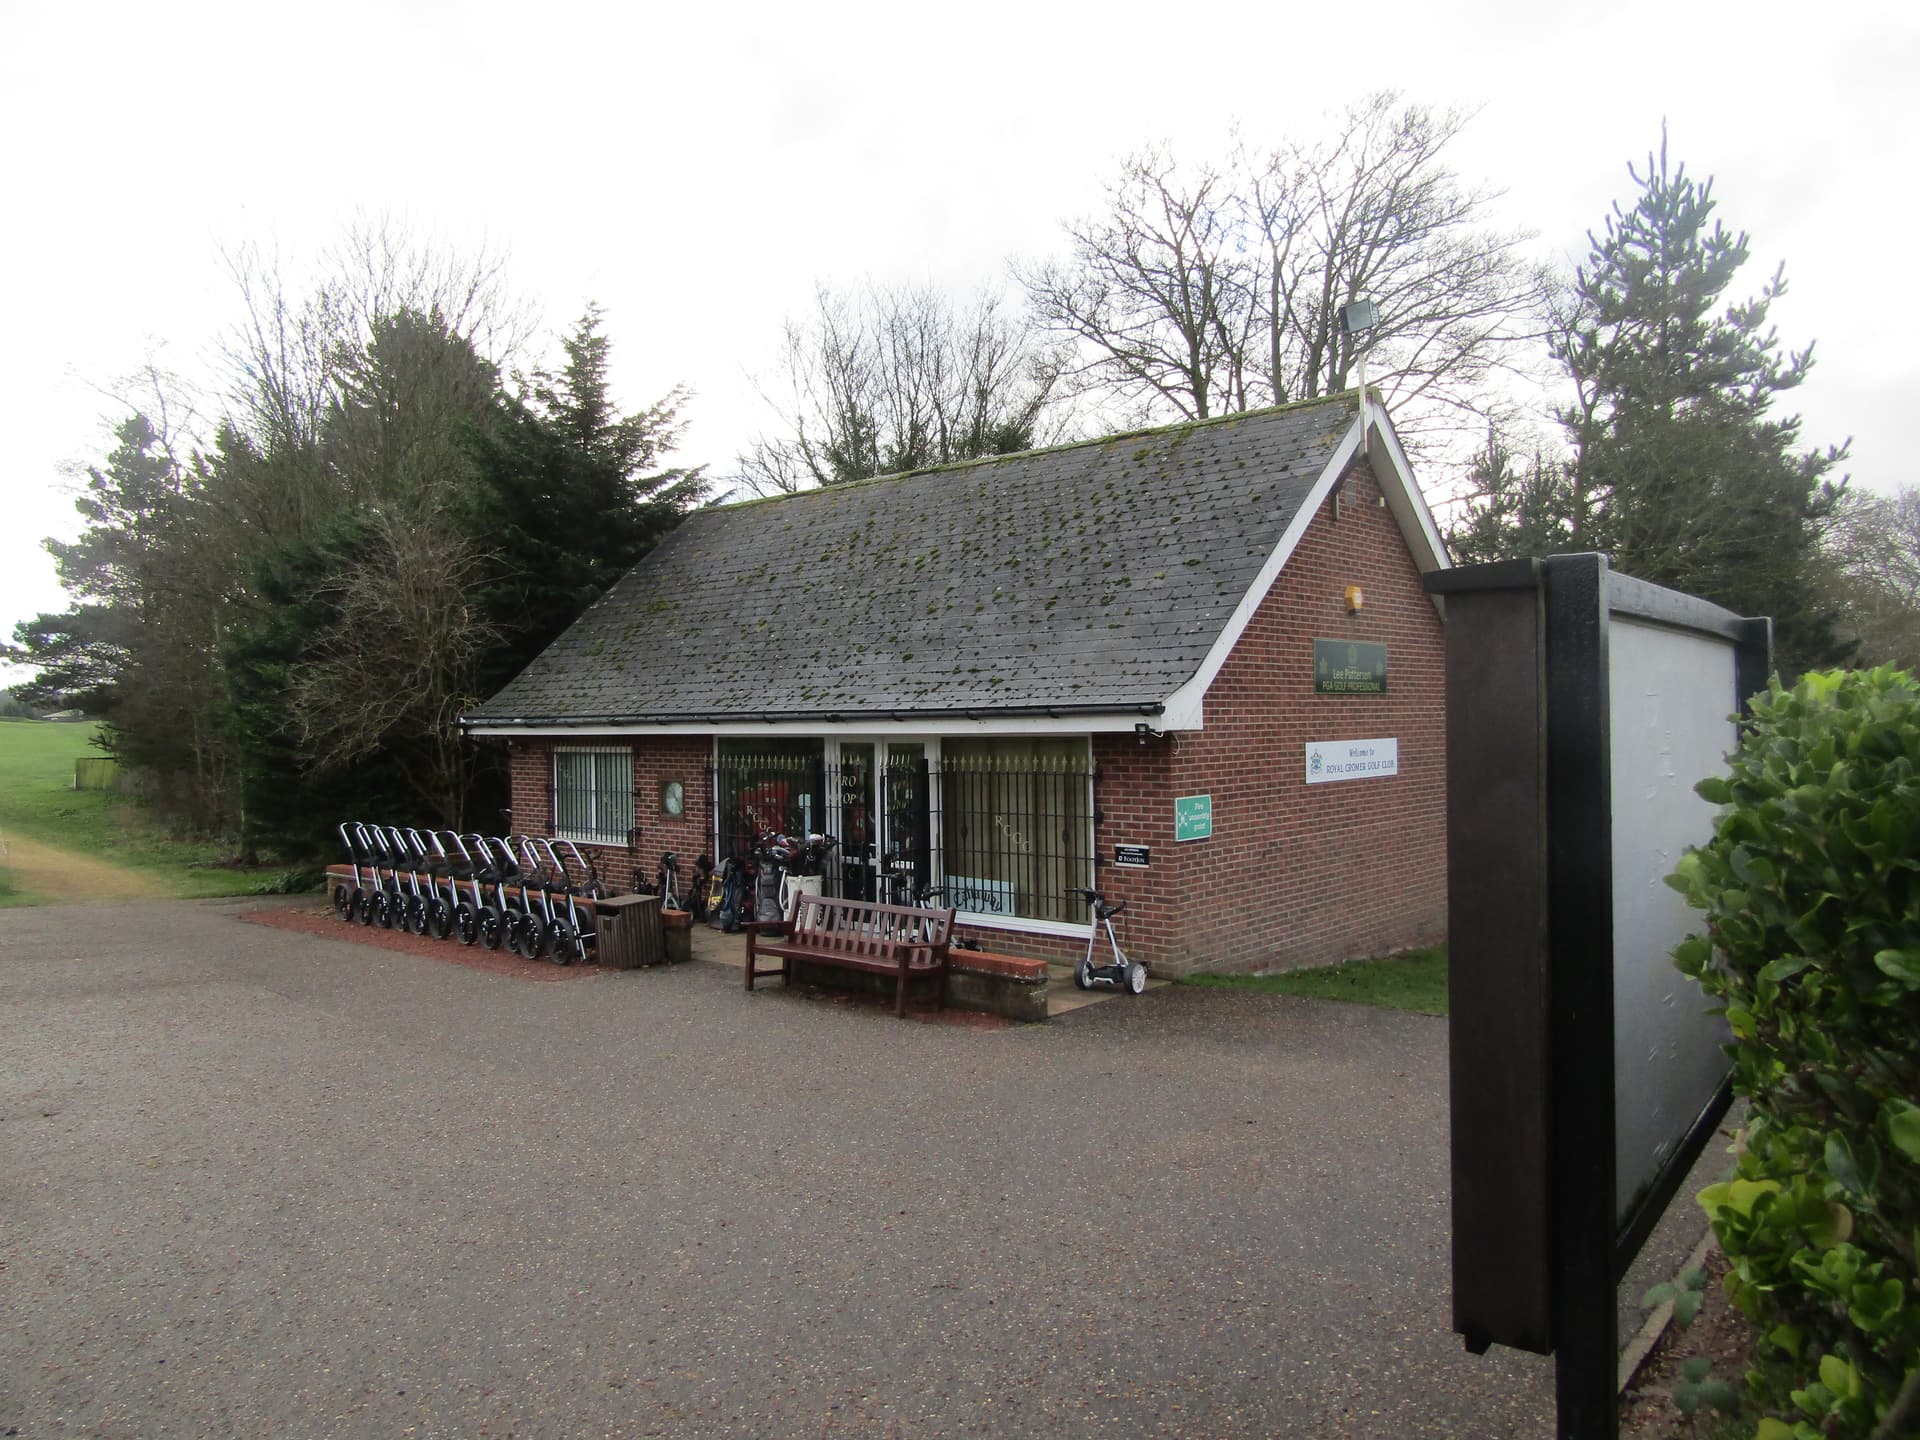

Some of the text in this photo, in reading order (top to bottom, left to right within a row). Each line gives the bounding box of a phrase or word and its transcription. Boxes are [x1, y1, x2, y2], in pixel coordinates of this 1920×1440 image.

[1333, 668, 1344, 680] Lee
[1349, 748, 1369, 757] Welcome
[1326, 760, 1394, 774] ROYAL CROMER GOLF CLUB
